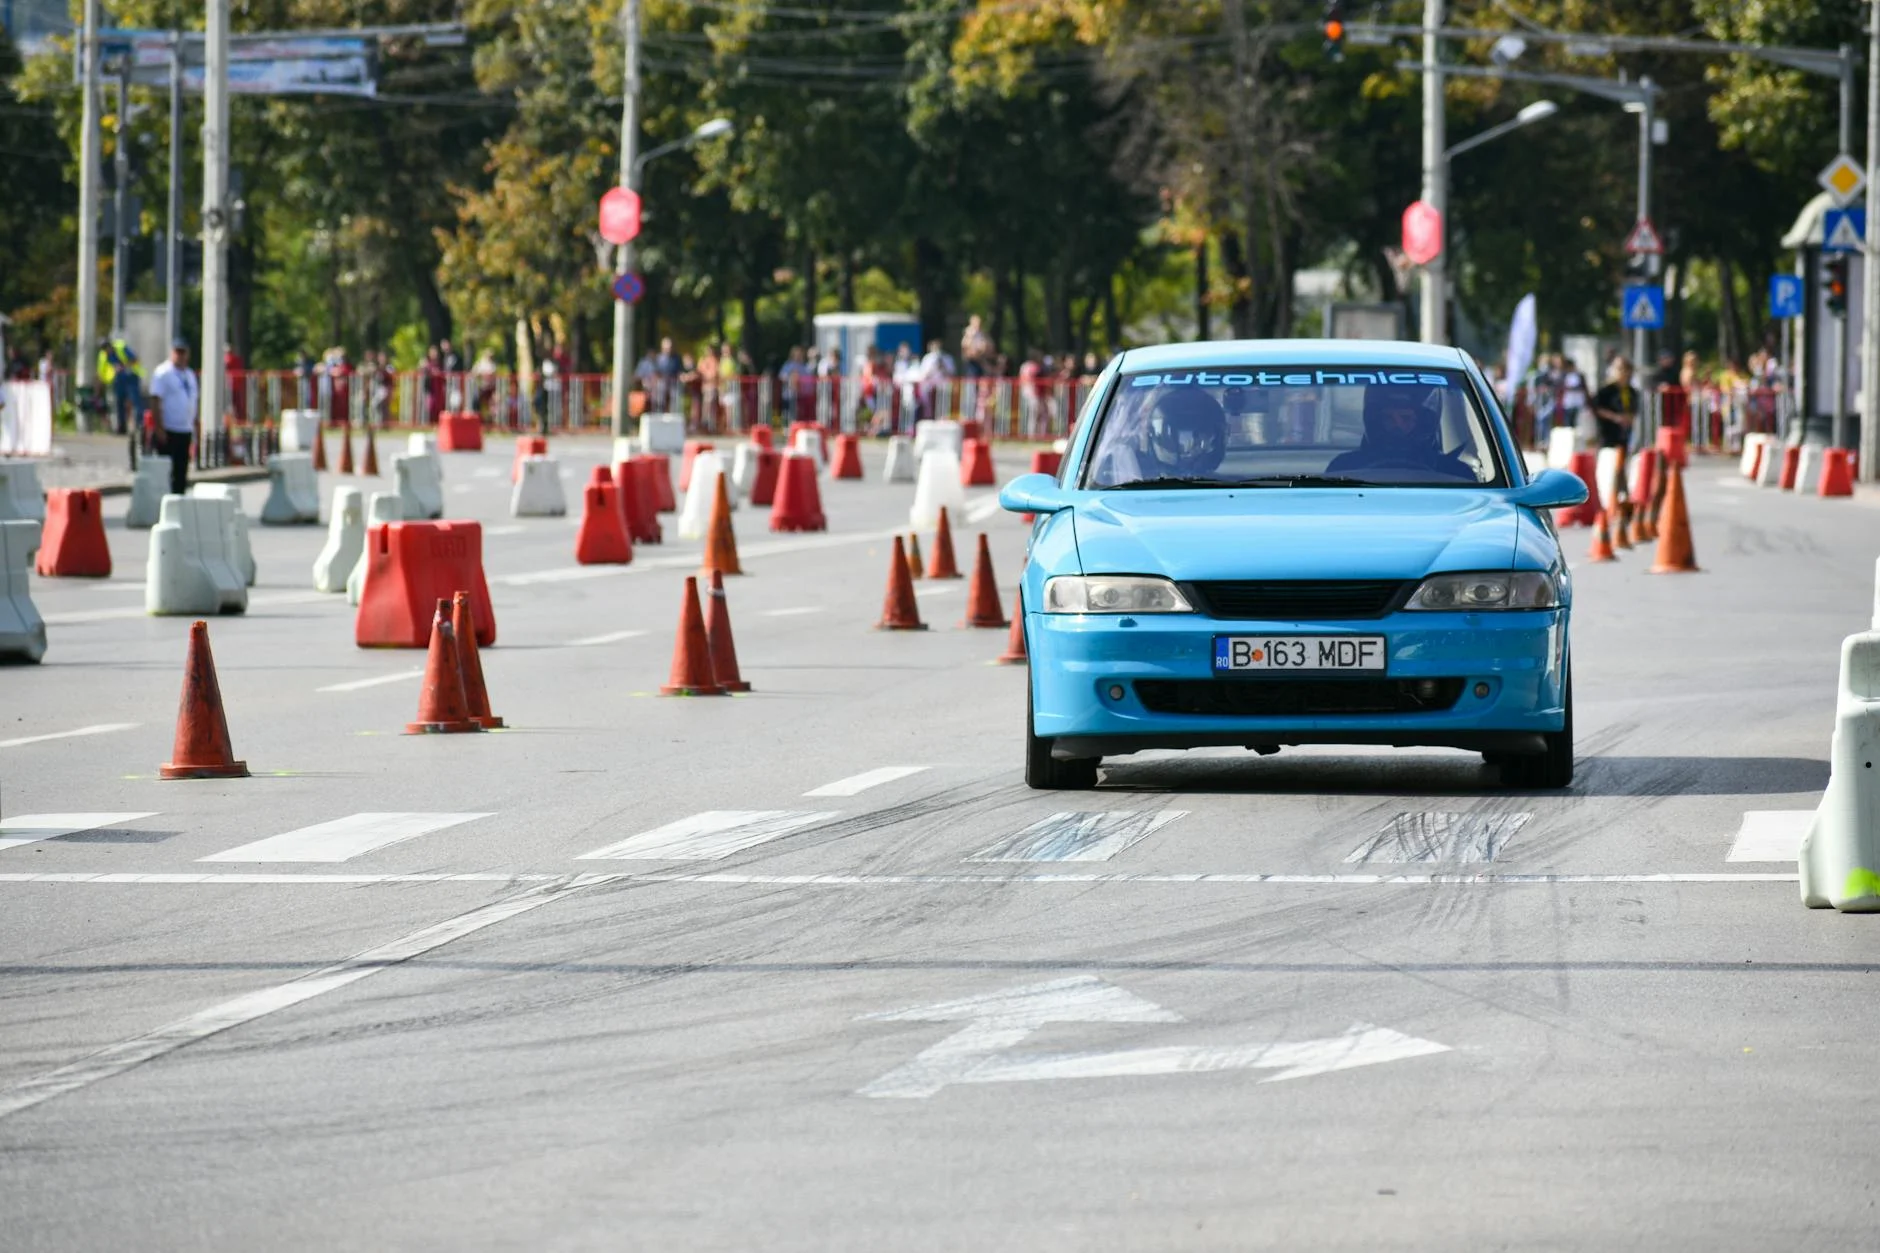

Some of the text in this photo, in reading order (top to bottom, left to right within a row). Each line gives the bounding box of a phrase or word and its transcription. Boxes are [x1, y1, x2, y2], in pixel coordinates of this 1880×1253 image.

[1776, 280, 1796, 308] P
[1131, 370, 1449, 387] autotehnica
[1216, 656, 1228, 668] RO
[1232, 641, 1377, 667] B 163 MDF
